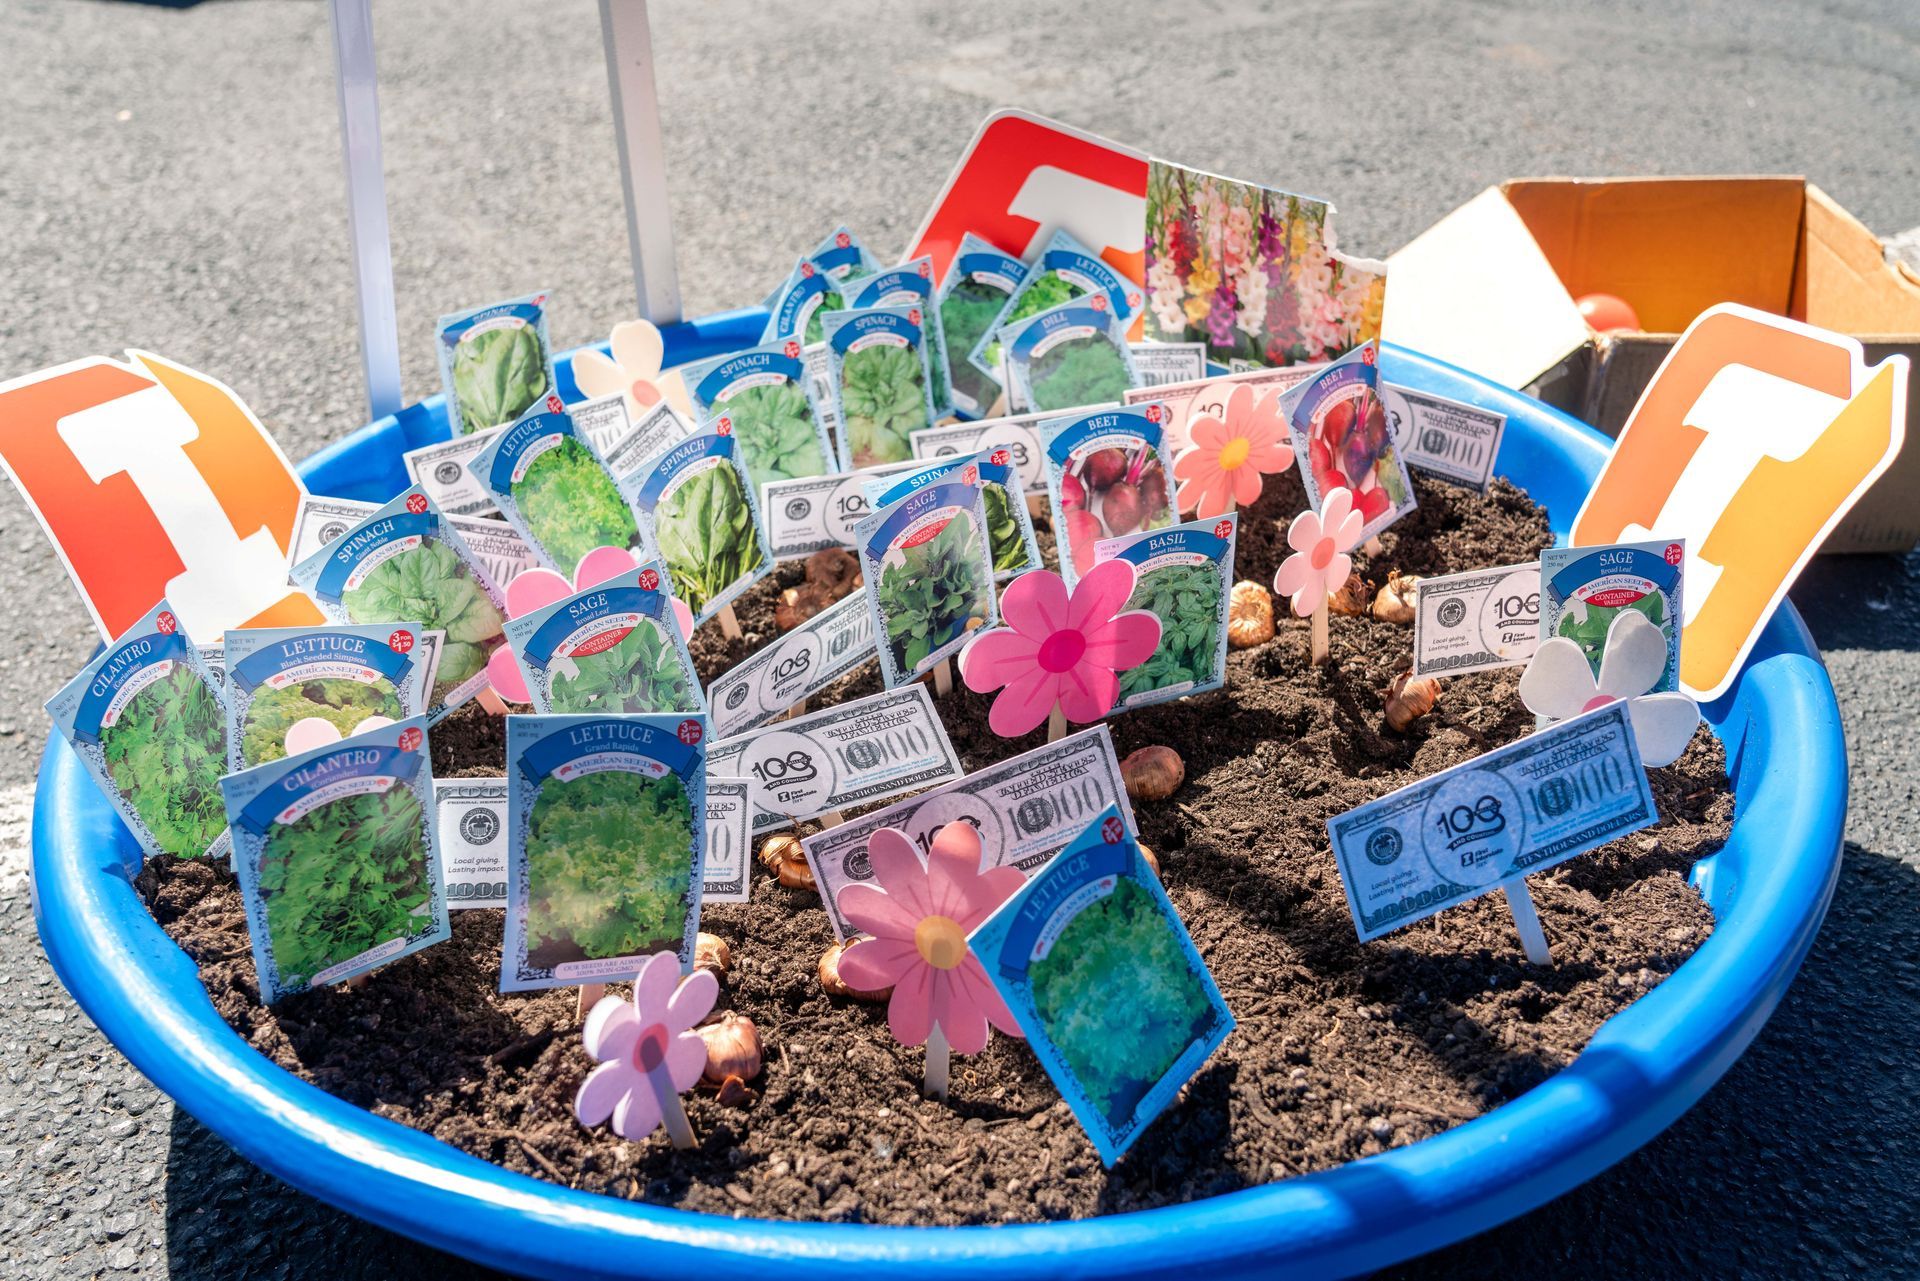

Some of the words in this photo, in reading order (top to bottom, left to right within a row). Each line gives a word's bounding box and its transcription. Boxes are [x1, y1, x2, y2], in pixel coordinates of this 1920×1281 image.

[876, 275, 902, 291] BASIL
[1076, 257, 1119, 293] LETTUCE
[779, 286, 806, 333] CILANTRO
[854, 316, 897, 331] SPINACH
[1041, 312, 1068, 329] DILL
[720, 354, 770, 378] SPINACH
[1319, 368, 1344, 390] BEET
[1087, 415, 1119, 431] BEET
[501, 417, 543, 457] LETTUCE
[660, 438, 705, 476] SPINACH
[910, 466, 956, 488] SPINA
[906, 491, 937, 514] SAGE
[1218, 522, 1223, 530] 3
[337, 519, 395, 563] SPINACH
[1149, 533, 1186, 551] BASIL
[1667, 546, 1673, 554] 3
[1599, 551, 1634, 566] SAGE
[641, 573, 647, 583] 3
[1601, 567, 1618, 575] Broad
[1586, 578, 1624, 590] AMERICAN
[1594, 592, 1635, 601] CONTAINER
[569, 593, 608, 618] SAGE
[157, 617, 165, 627] 3
[575, 613, 595, 627] Broad
[595, 607, 610, 617] Leaf
[511, 623, 525, 632] NET
[524, 620, 534, 628] WT
[566, 622, 605, 647] AMERICAN
[605, 615, 628, 625] SEED
[393, 633, 400, 642] 3
[580, 630, 623, 652] CONTAINER
[281, 637, 366, 657] LETTUCE
[591, 639, 616, 654] VARIETY
[1428, 644, 1449, 652] Lasting
[92, 640, 151, 697] CILANTRO
[280, 659, 303, 670] Black
[303, 653, 333, 664] Seeded
[334, 653, 368, 665] Simpson
[285, 666, 334, 679] AMERICAN
[335, 667, 364, 675] SEED
[111, 677, 141, 712] AMERICAN
[140, 666, 160, 681] SEED
[569, 724, 655, 746] LETTUCE
[681, 722, 688, 733] 3
[401, 732, 408, 742] 3
[585, 743, 611, 752] Grand
[612, 741, 639, 753] Rapids
[284, 750, 381, 792] CILANTRO
[571, 756, 623, 771] AMERICAN
[623, 757, 651, 768] SEED
[836, 793, 854, 803] TEN
[855, 780, 904, 798] THOUSAND
[904, 768, 948, 783] DOLLARS
[296, 784, 346, 811] AMERICAN
[347, 779, 377, 791] SEED
[791, 790, 817, 800] Interstate
[1452, 835, 1465, 848] AND
[1521, 849, 1544, 867] TEN
[1544, 828, 1596, 858] THOUSAND
[1595, 811, 1642, 836] DOLLARS
[448, 866, 476, 874] Lasting
[1023, 853, 1090, 921] LETTUCE
[1371, 877, 1389, 890] Local
[1368, 886, 1394, 901] Lasting
[581, 962, 603, 970] SEEDS
[596, 966, 634, 974] NON-GMO
